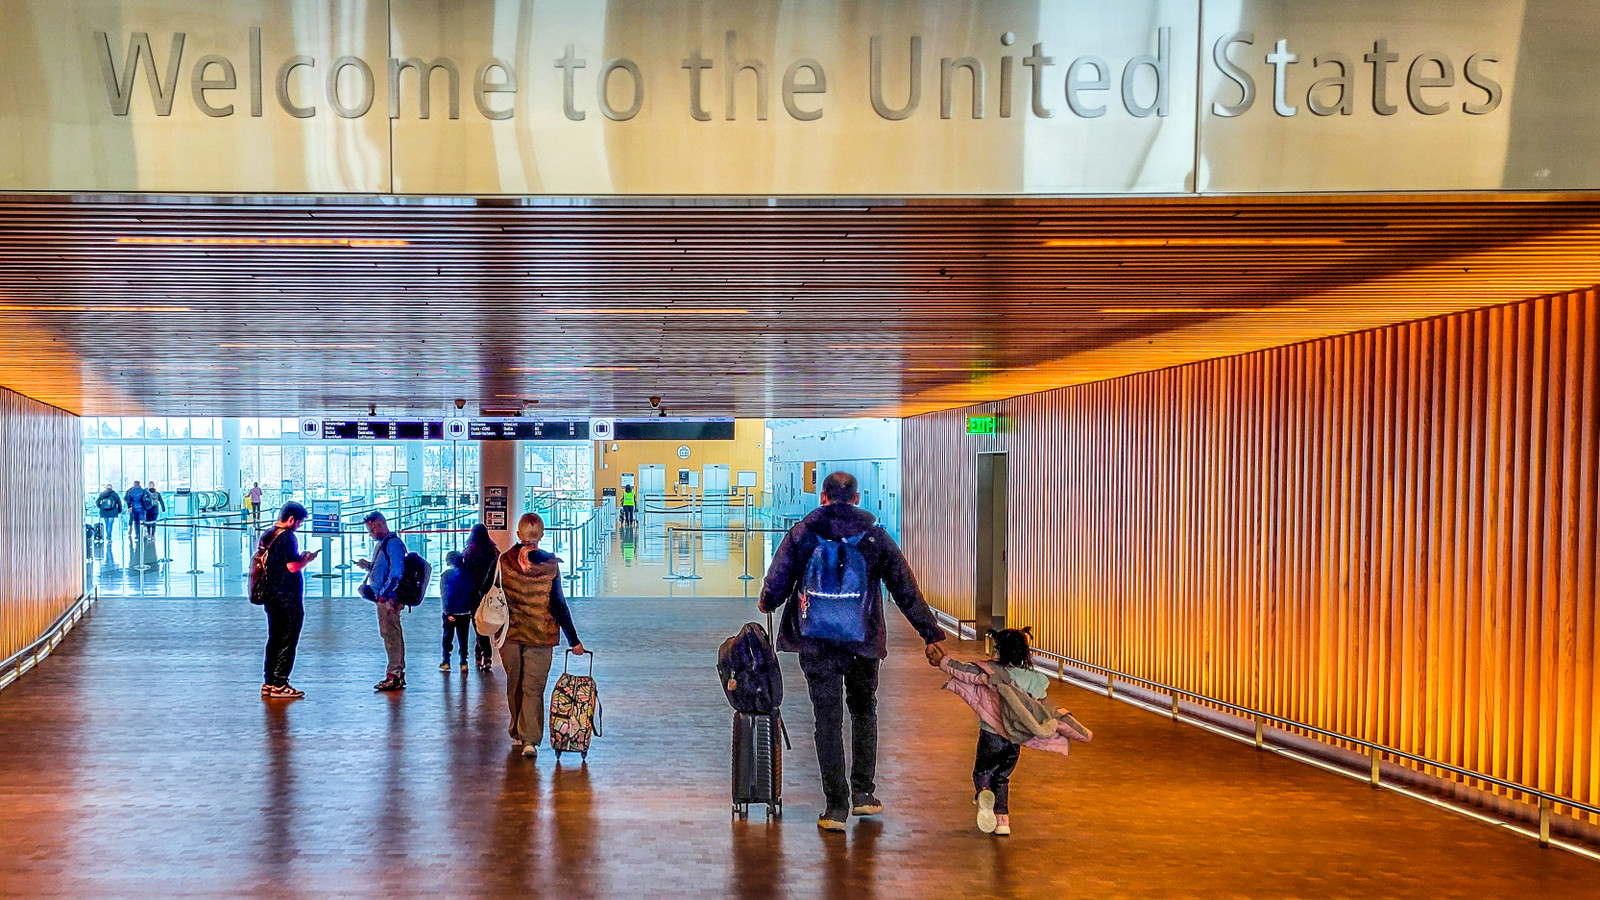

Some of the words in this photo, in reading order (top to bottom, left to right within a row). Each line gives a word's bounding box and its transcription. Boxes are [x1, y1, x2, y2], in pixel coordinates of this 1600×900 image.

[93, 26, 519, 121] Welcome
[554, 44, 645, 122] to
[682, 30, 827, 122] the
[868, 26, 1171, 120] United
[1211, 31, 1502, 118] States
[970, 418, 991, 432] EXIT
